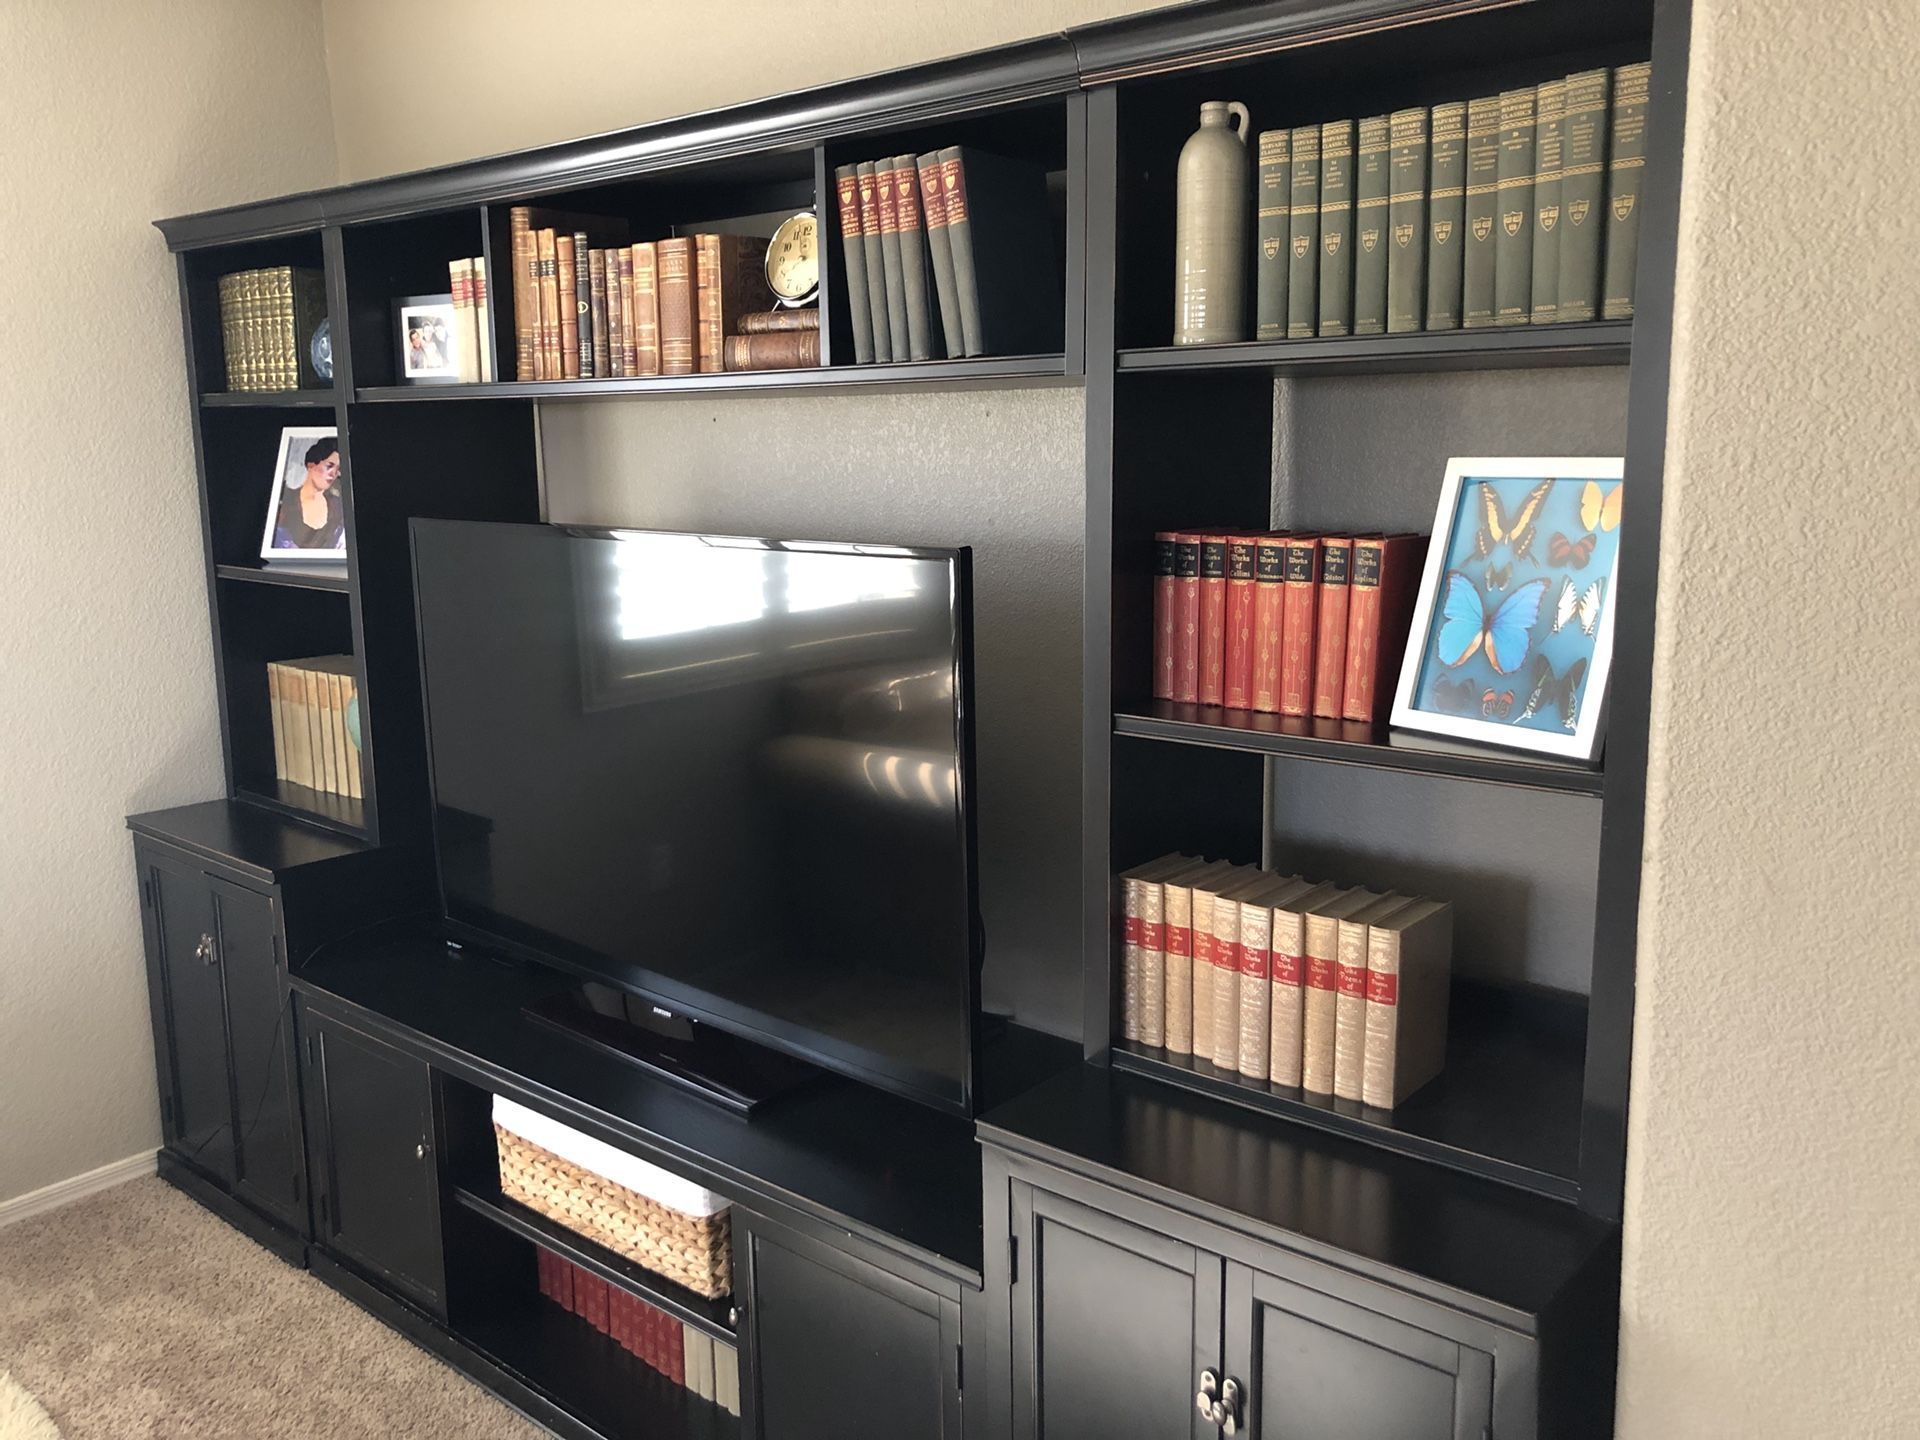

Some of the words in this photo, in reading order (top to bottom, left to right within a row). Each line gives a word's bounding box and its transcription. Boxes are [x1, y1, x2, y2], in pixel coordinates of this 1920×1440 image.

[1501, 102, 1533, 113] HARVARD
[1501, 110, 1532, 120] CLASSICS
[1392, 122, 1421, 131] HARVARD
[1433, 124, 1461, 133] CLASSICS
[1392, 129, 1420, 138] CLASSICS
[803, 225, 812, 236] 12
[793, 231, 800, 240] 11
[784, 242, 792, 252] 10
[779, 256, 785, 266] 9
[786, 279, 792, 289] 7
[1233, 546, 1246, 554] The
[1361, 550, 1373, 558] The
[1259, 556, 1279, 564] Works
[1289, 556, 1308, 564] Works
[1325, 555, 1344, 563] Works
[1357, 558, 1377, 566] Works
[1217, 946, 1233, 956] Works
[1247, 947, 1258, 955] The
[1244, 953, 1261, 963] Works
[1280, 954, 1291, 963] The
[1277, 961, 1294, 970] Works
[1311, 965, 1328, 974] Works
[1374, 972, 1384, 980] The
